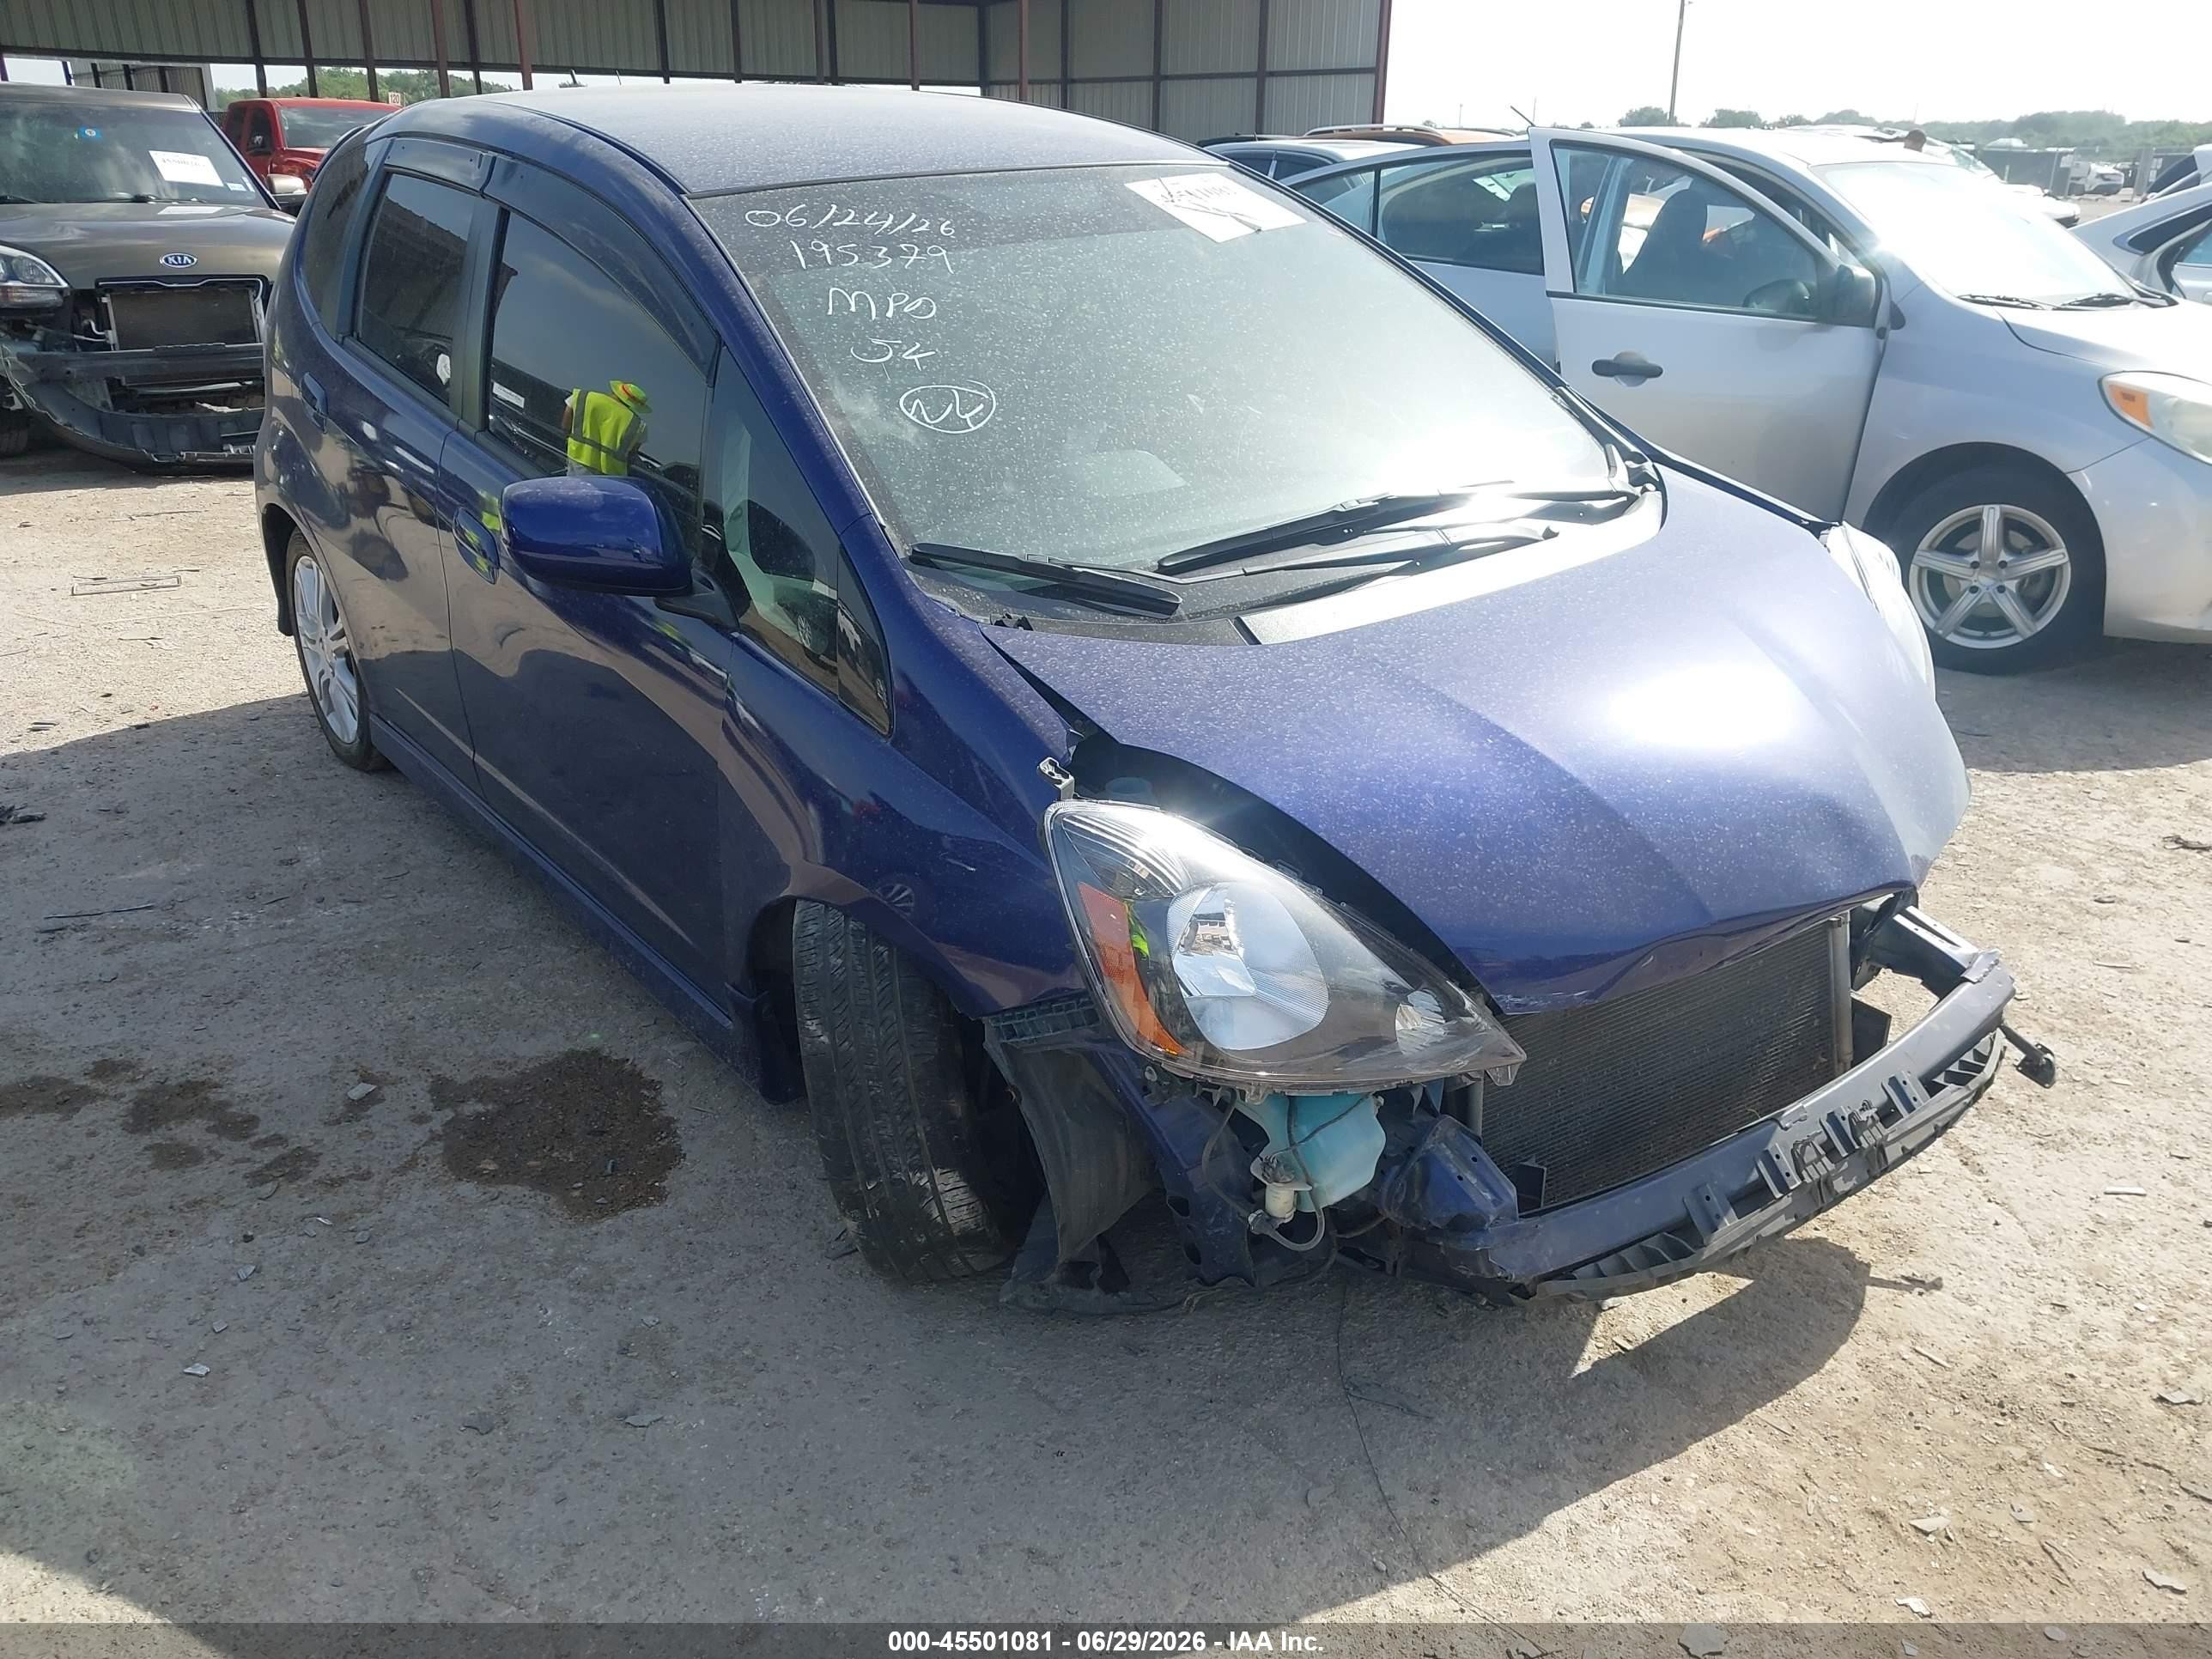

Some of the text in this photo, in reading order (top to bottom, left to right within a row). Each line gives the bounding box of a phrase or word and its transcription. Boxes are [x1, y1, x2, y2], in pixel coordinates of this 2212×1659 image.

[744, 204, 956, 236] 06/24/26
[167, 255, 191, 264] KIA
[789, 240, 954, 275] 195379
